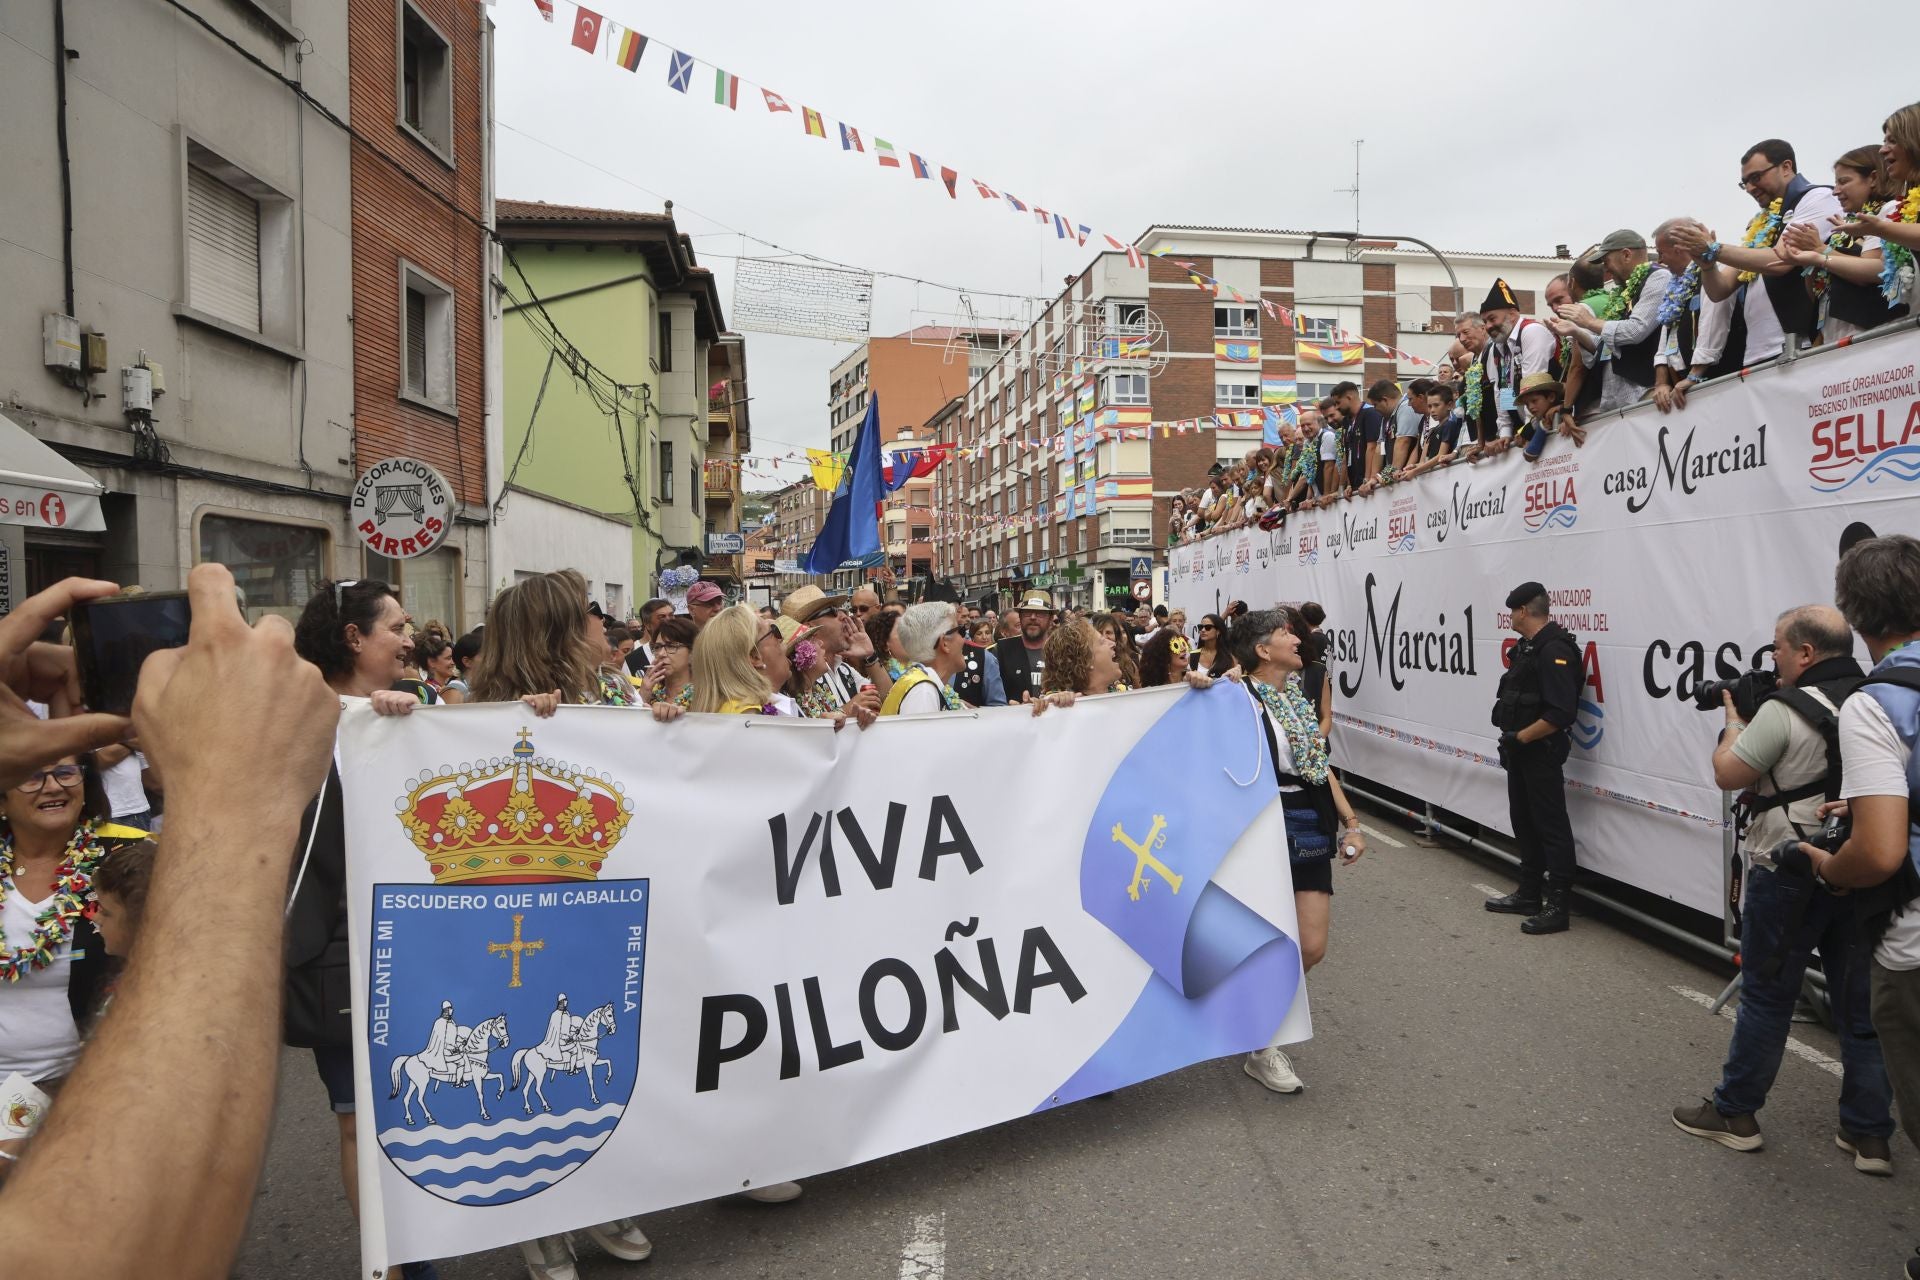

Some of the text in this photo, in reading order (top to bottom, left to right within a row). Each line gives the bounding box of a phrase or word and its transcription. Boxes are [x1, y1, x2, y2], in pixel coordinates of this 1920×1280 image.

[1822, 377, 1850, 399] COMITÉ
[1852, 365, 1914, 391] ORGANIZADOR
[1808, 398, 1848, 418] DESCENSO
[1850, 384, 1916, 409] INTERNACIONAL
[354, 460, 444, 507] DECORACIONES
[1603, 424, 1767, 513] casa Marcial
[15, 500, 35, 517] en
[1427, 509, 1447, 528] casa
[1437, 481, 1506, 543] Marcial
[1524, 476, 1577, 513] SELLA
[358, 516, 443, 555] PARRES
[1299, 535, 1318, 554] SELLA
[1326, 532, 1341, 548] casa
[1334, 511, 1378, 559] Marcial
[1388, 514, 1416, 539] SELLA
[1104, 586, 1131, 595] FARM
[1548, 589, 1591, 607] ANIZADOR
[1339, 572, 1477, 698] Marcial
[1549, 614, 1609, 631] NACIONAL DEL
[1325, 628, 1358, 663] asa
[768, 794, 984, 906] VIVA
[382, 889, 642, 909] ESCUDERO QUE MI CABALLO
[1731, 879, 1739, 903] Canon
[374, 920, 393, 1046] ADELANTE MI
[624, 925, 641, 1013] PIE HALLA
[695, 916, 1088, 1093] PILOÑA
